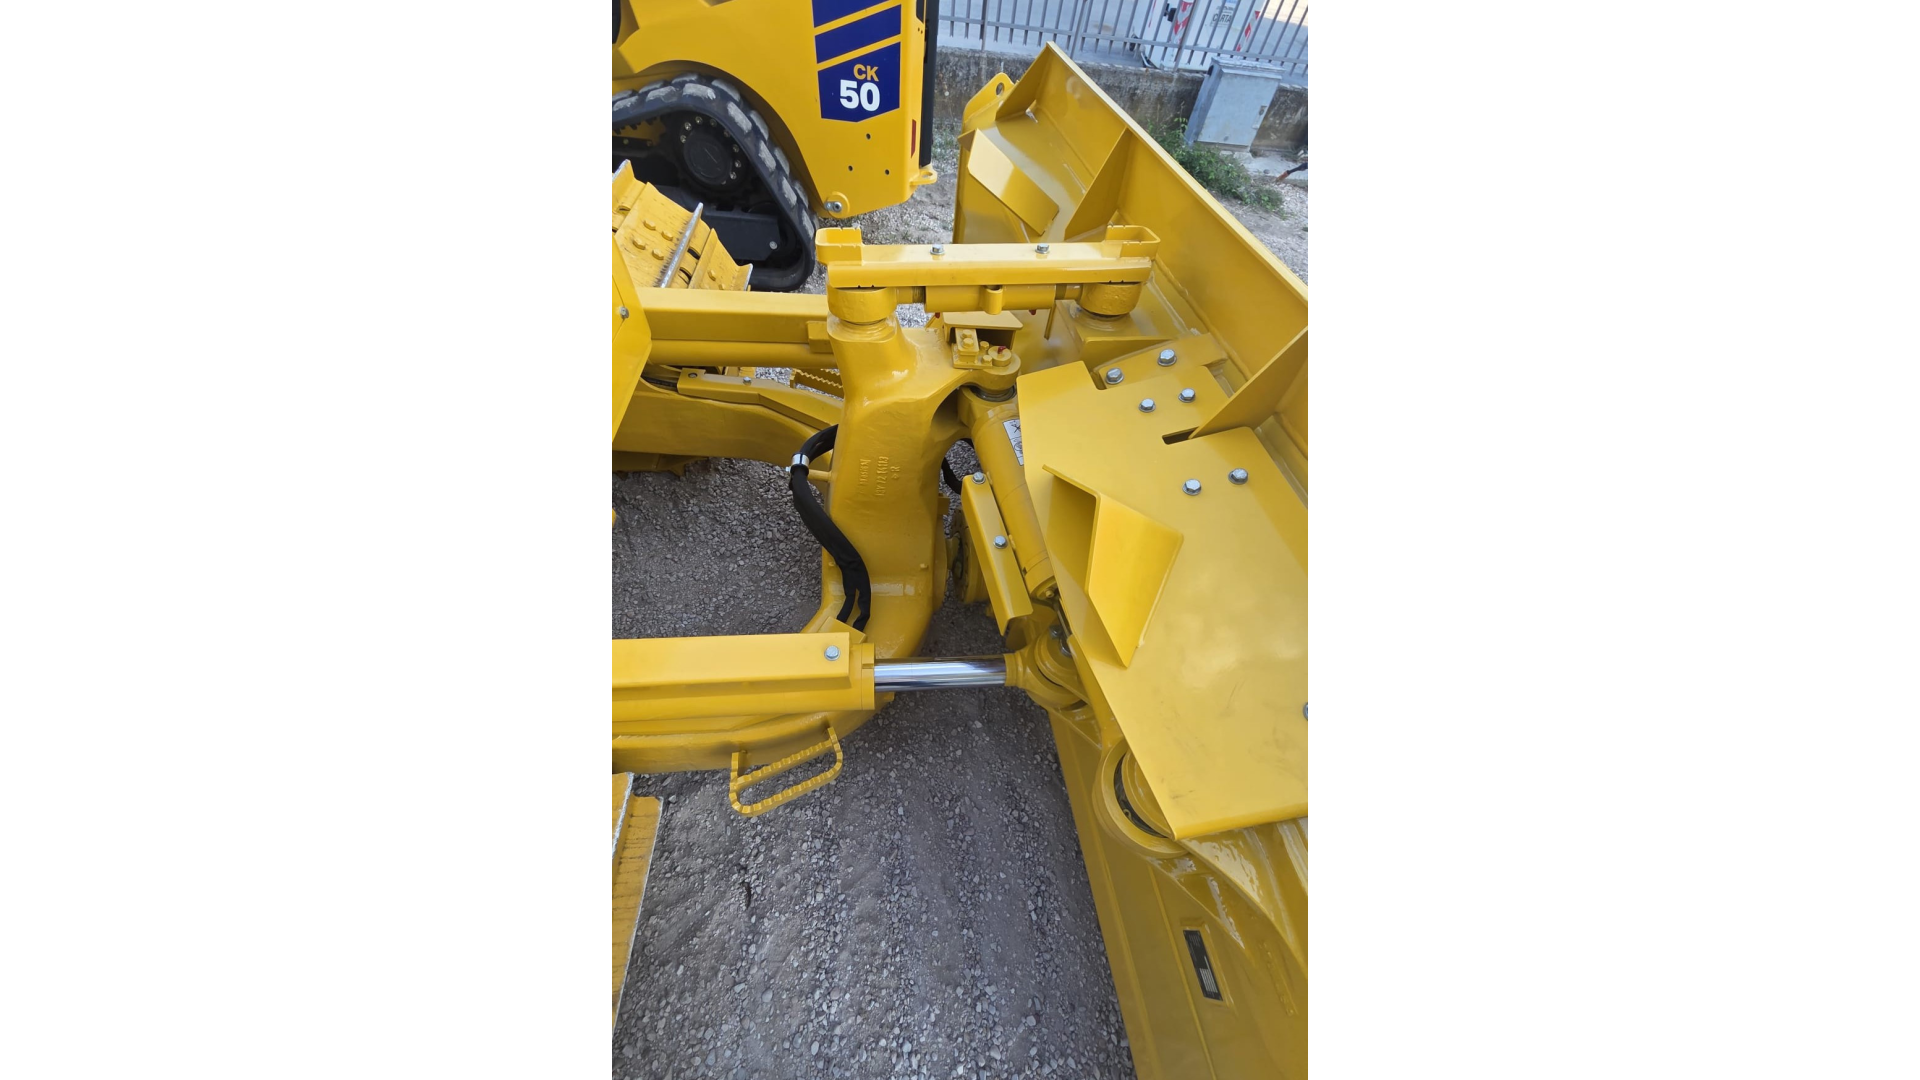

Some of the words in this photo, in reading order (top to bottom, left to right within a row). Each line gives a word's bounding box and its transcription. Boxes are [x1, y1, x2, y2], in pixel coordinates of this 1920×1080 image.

[1212, 13, 1232, 23] CRTA
[853, 64, 879, 82] CK
[840, 79, 880, 112] 50
